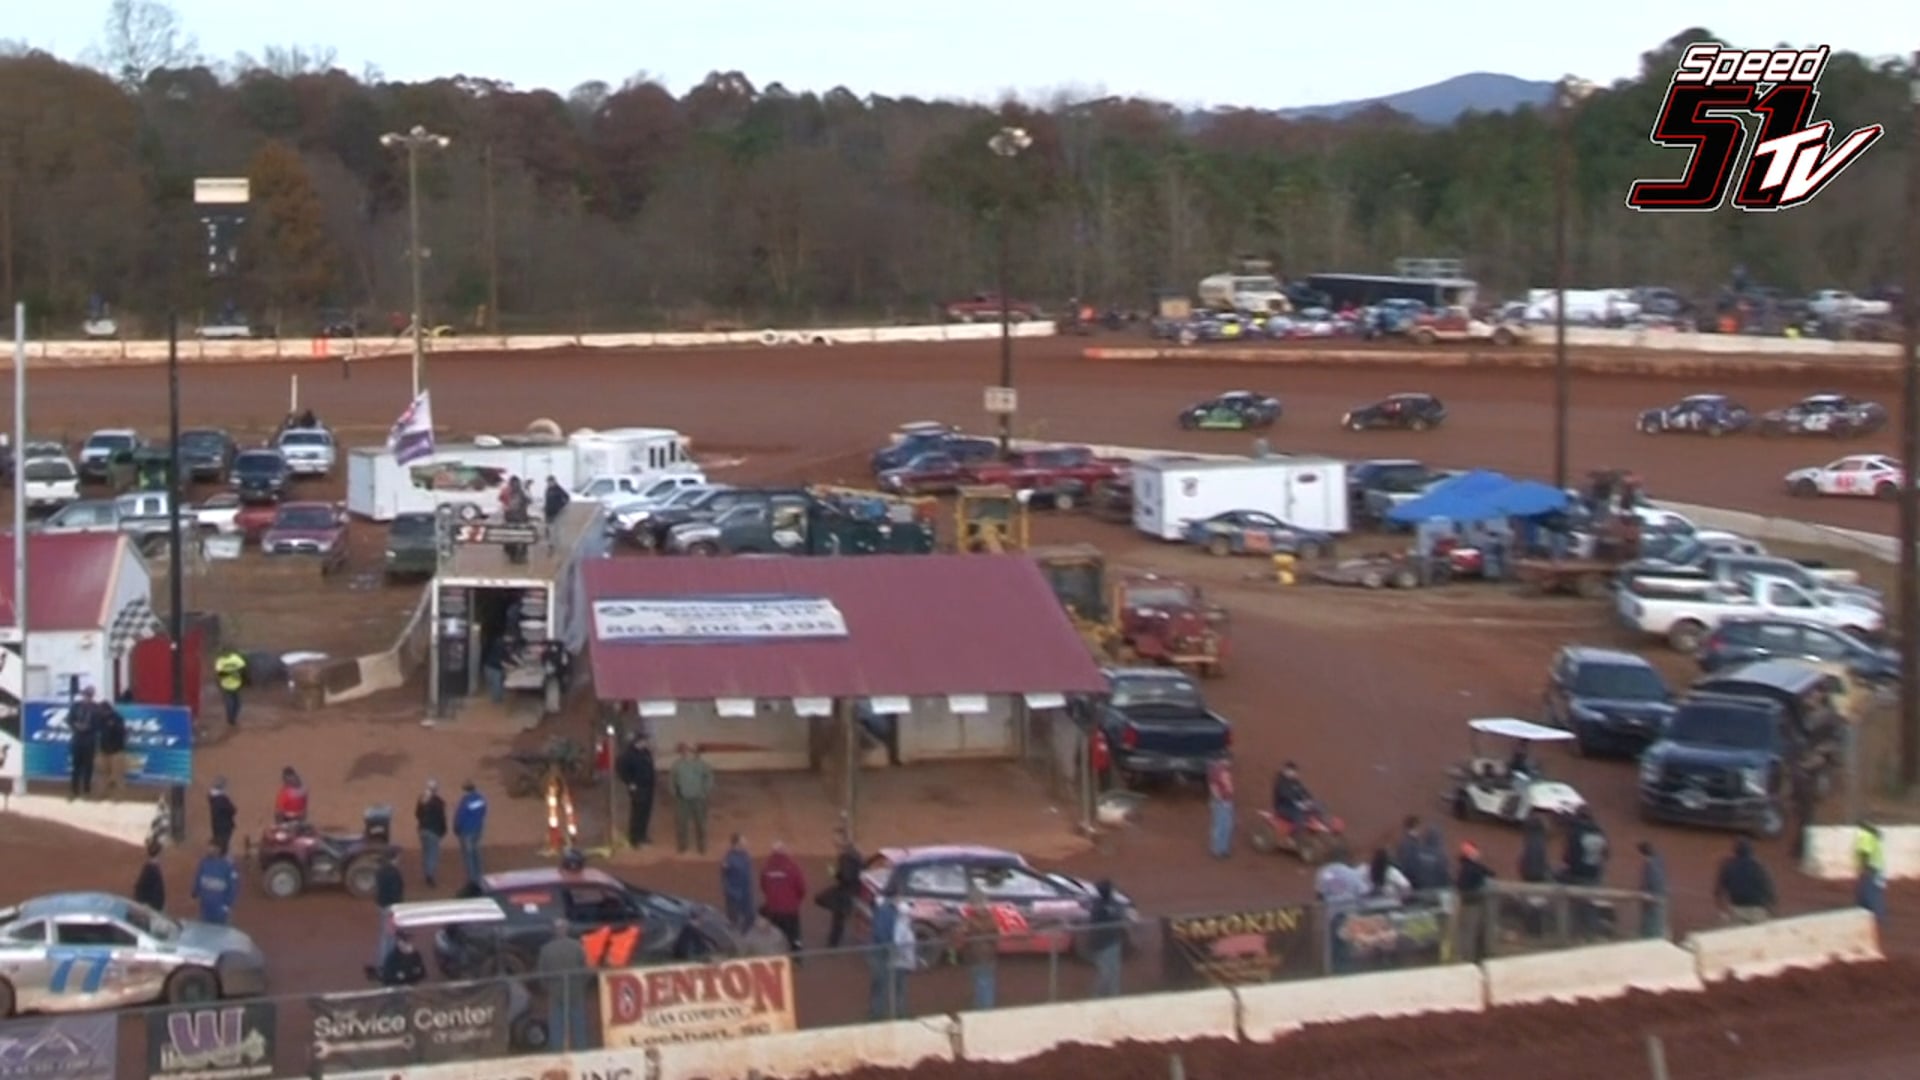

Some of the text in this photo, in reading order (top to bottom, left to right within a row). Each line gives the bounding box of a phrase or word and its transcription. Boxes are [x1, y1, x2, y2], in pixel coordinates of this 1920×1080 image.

[46, 949, 113, 994] 77
[607, 961, 787, 1026] DENTON
[314, 1006, 496, 1039] Service Center
